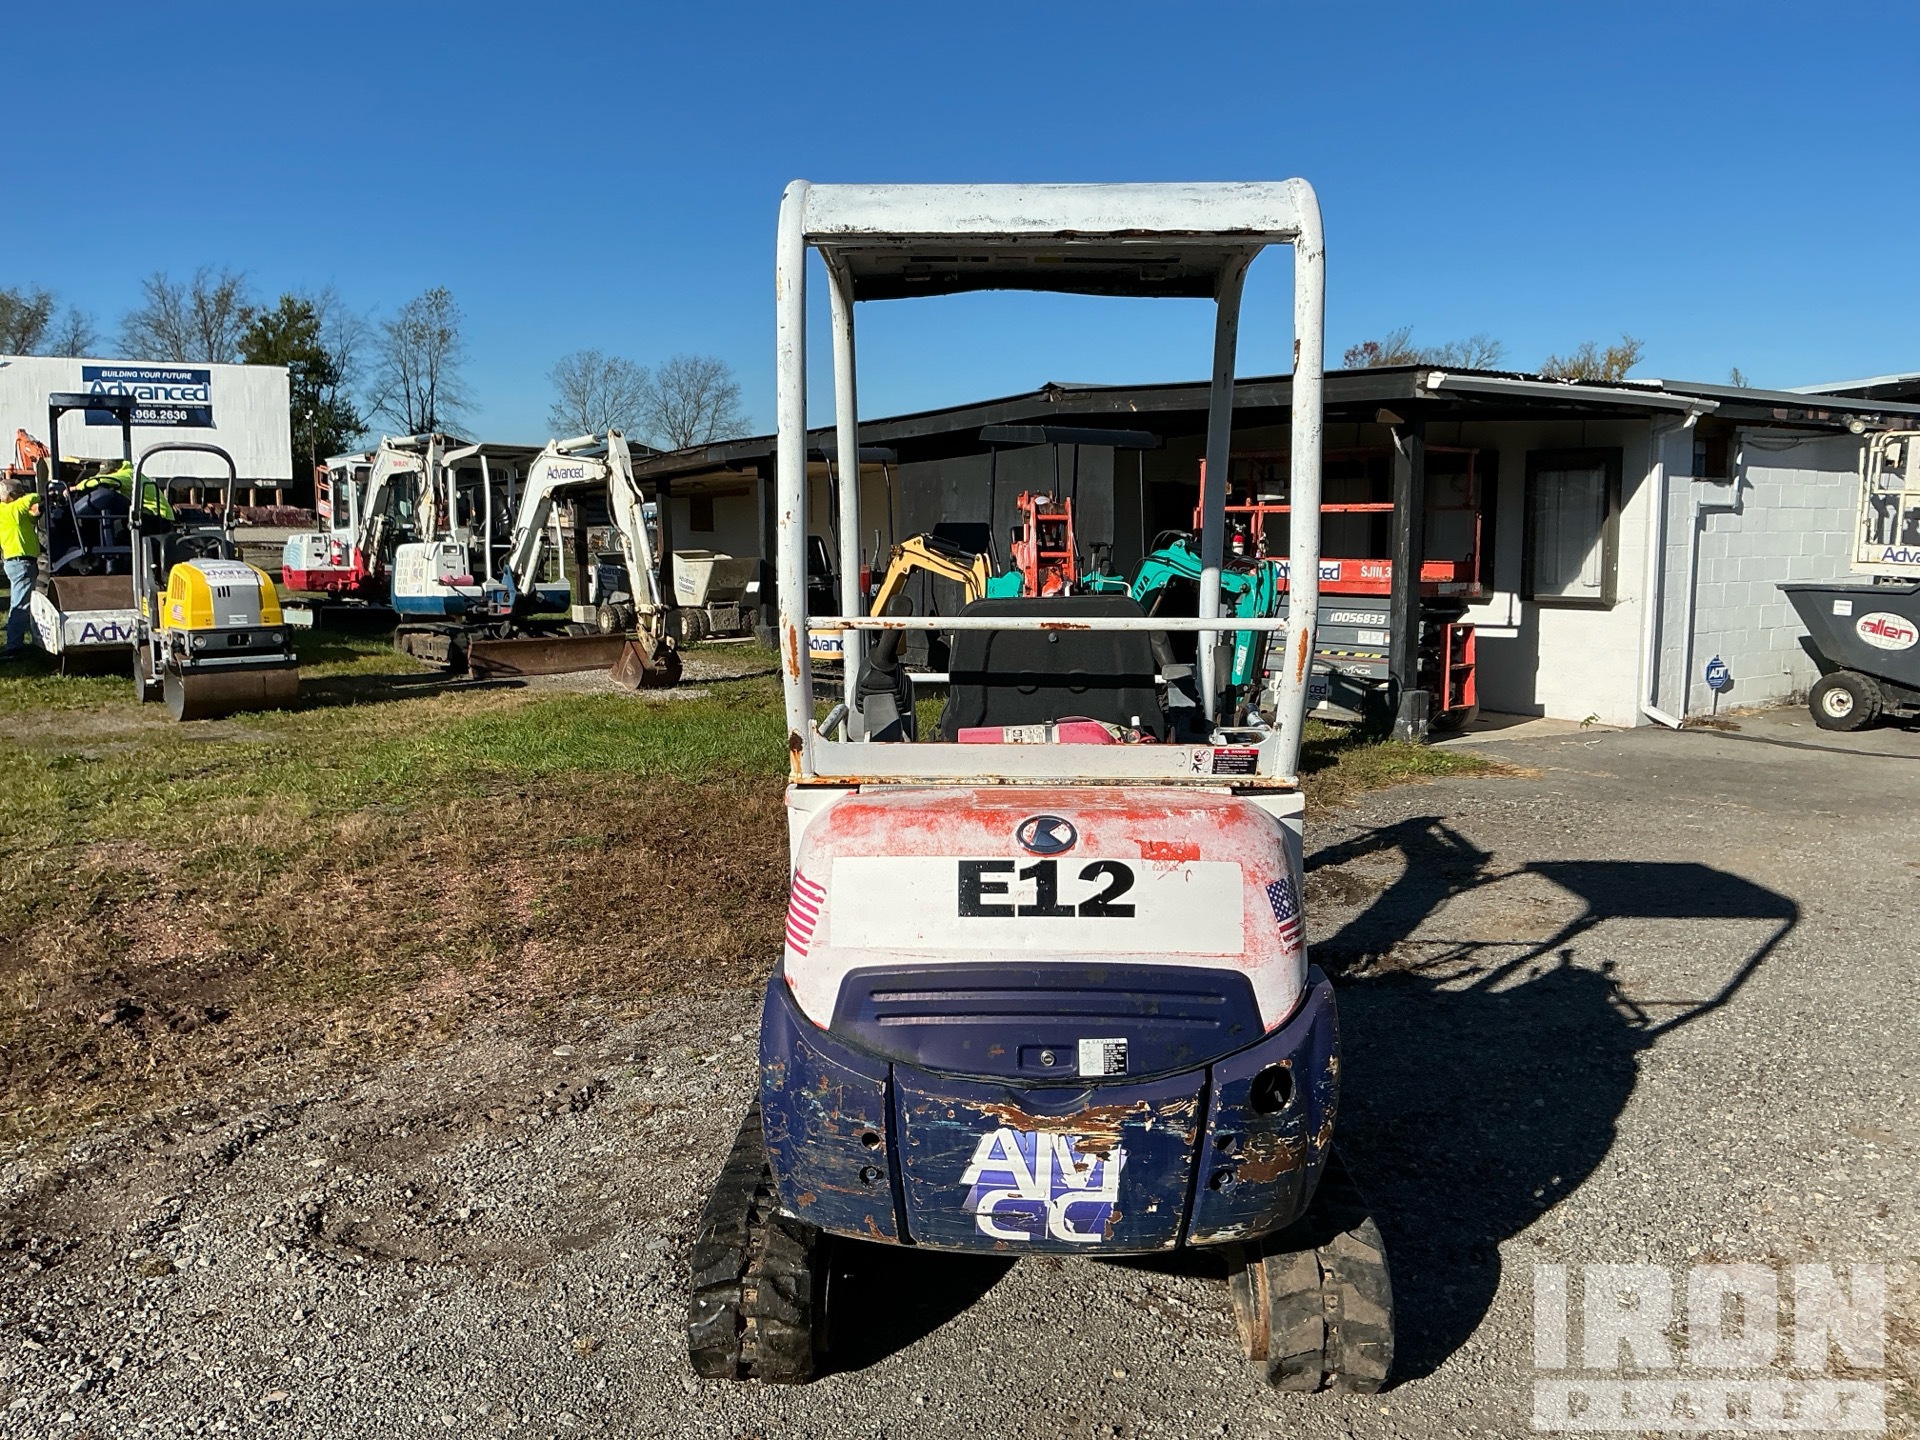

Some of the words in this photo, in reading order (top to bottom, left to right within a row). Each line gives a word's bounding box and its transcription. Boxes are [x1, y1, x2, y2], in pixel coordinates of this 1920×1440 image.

[101, 370, 137, 378] BUILDING
[139, 371, 160, 379] YOUR
[162, 372, 192, 380] FUTURE
[90, 379, 209, 402] Advanced
[130, 409, 188, 420] .966.2636
[547, 464, 584, 479] Advanced
[1329, 612, 1386, 625] 10056833
[1861, 618, 1914, 643] allen
[1708, 667, 1727, 679] ADT
[958, 859, 1136, 918] E12
